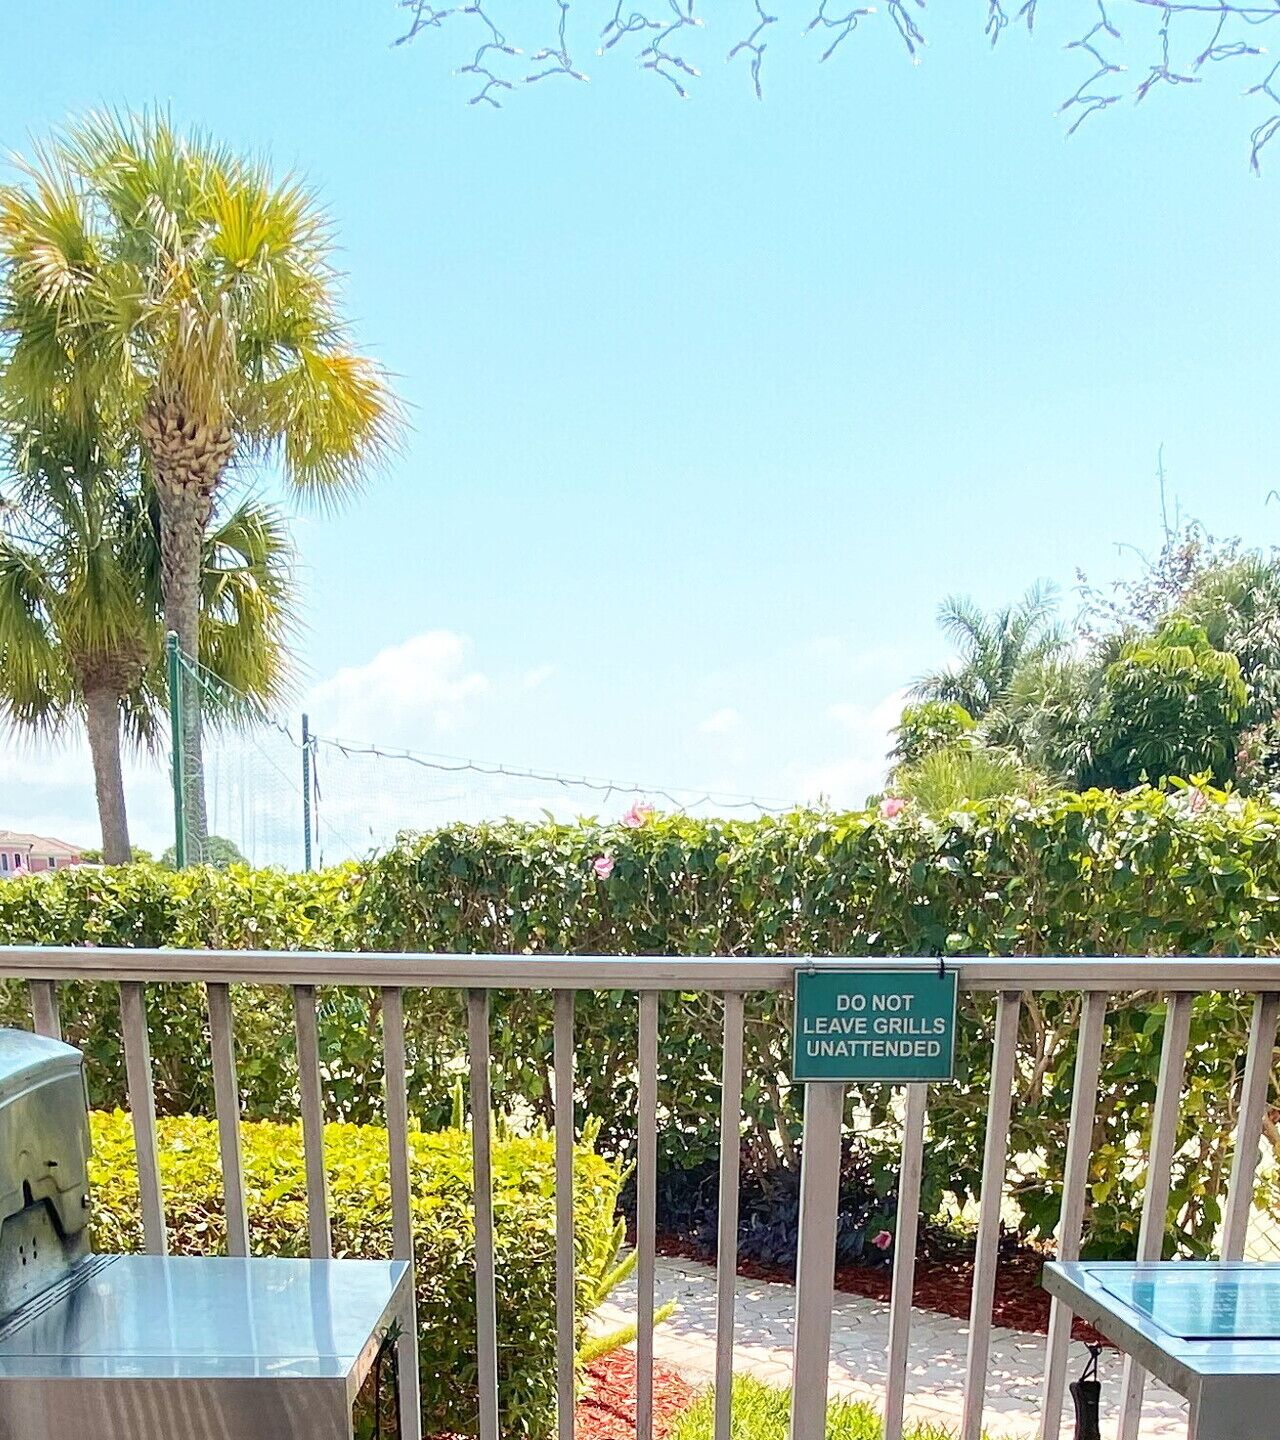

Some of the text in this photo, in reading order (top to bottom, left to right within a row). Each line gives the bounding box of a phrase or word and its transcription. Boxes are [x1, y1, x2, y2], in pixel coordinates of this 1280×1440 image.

[836, 994, 914, 1011] DO NOT
[803, 1017, 946, 1035] LEAVE GRILLS
[806, 1041, 941, 1057] UNATTENDED
